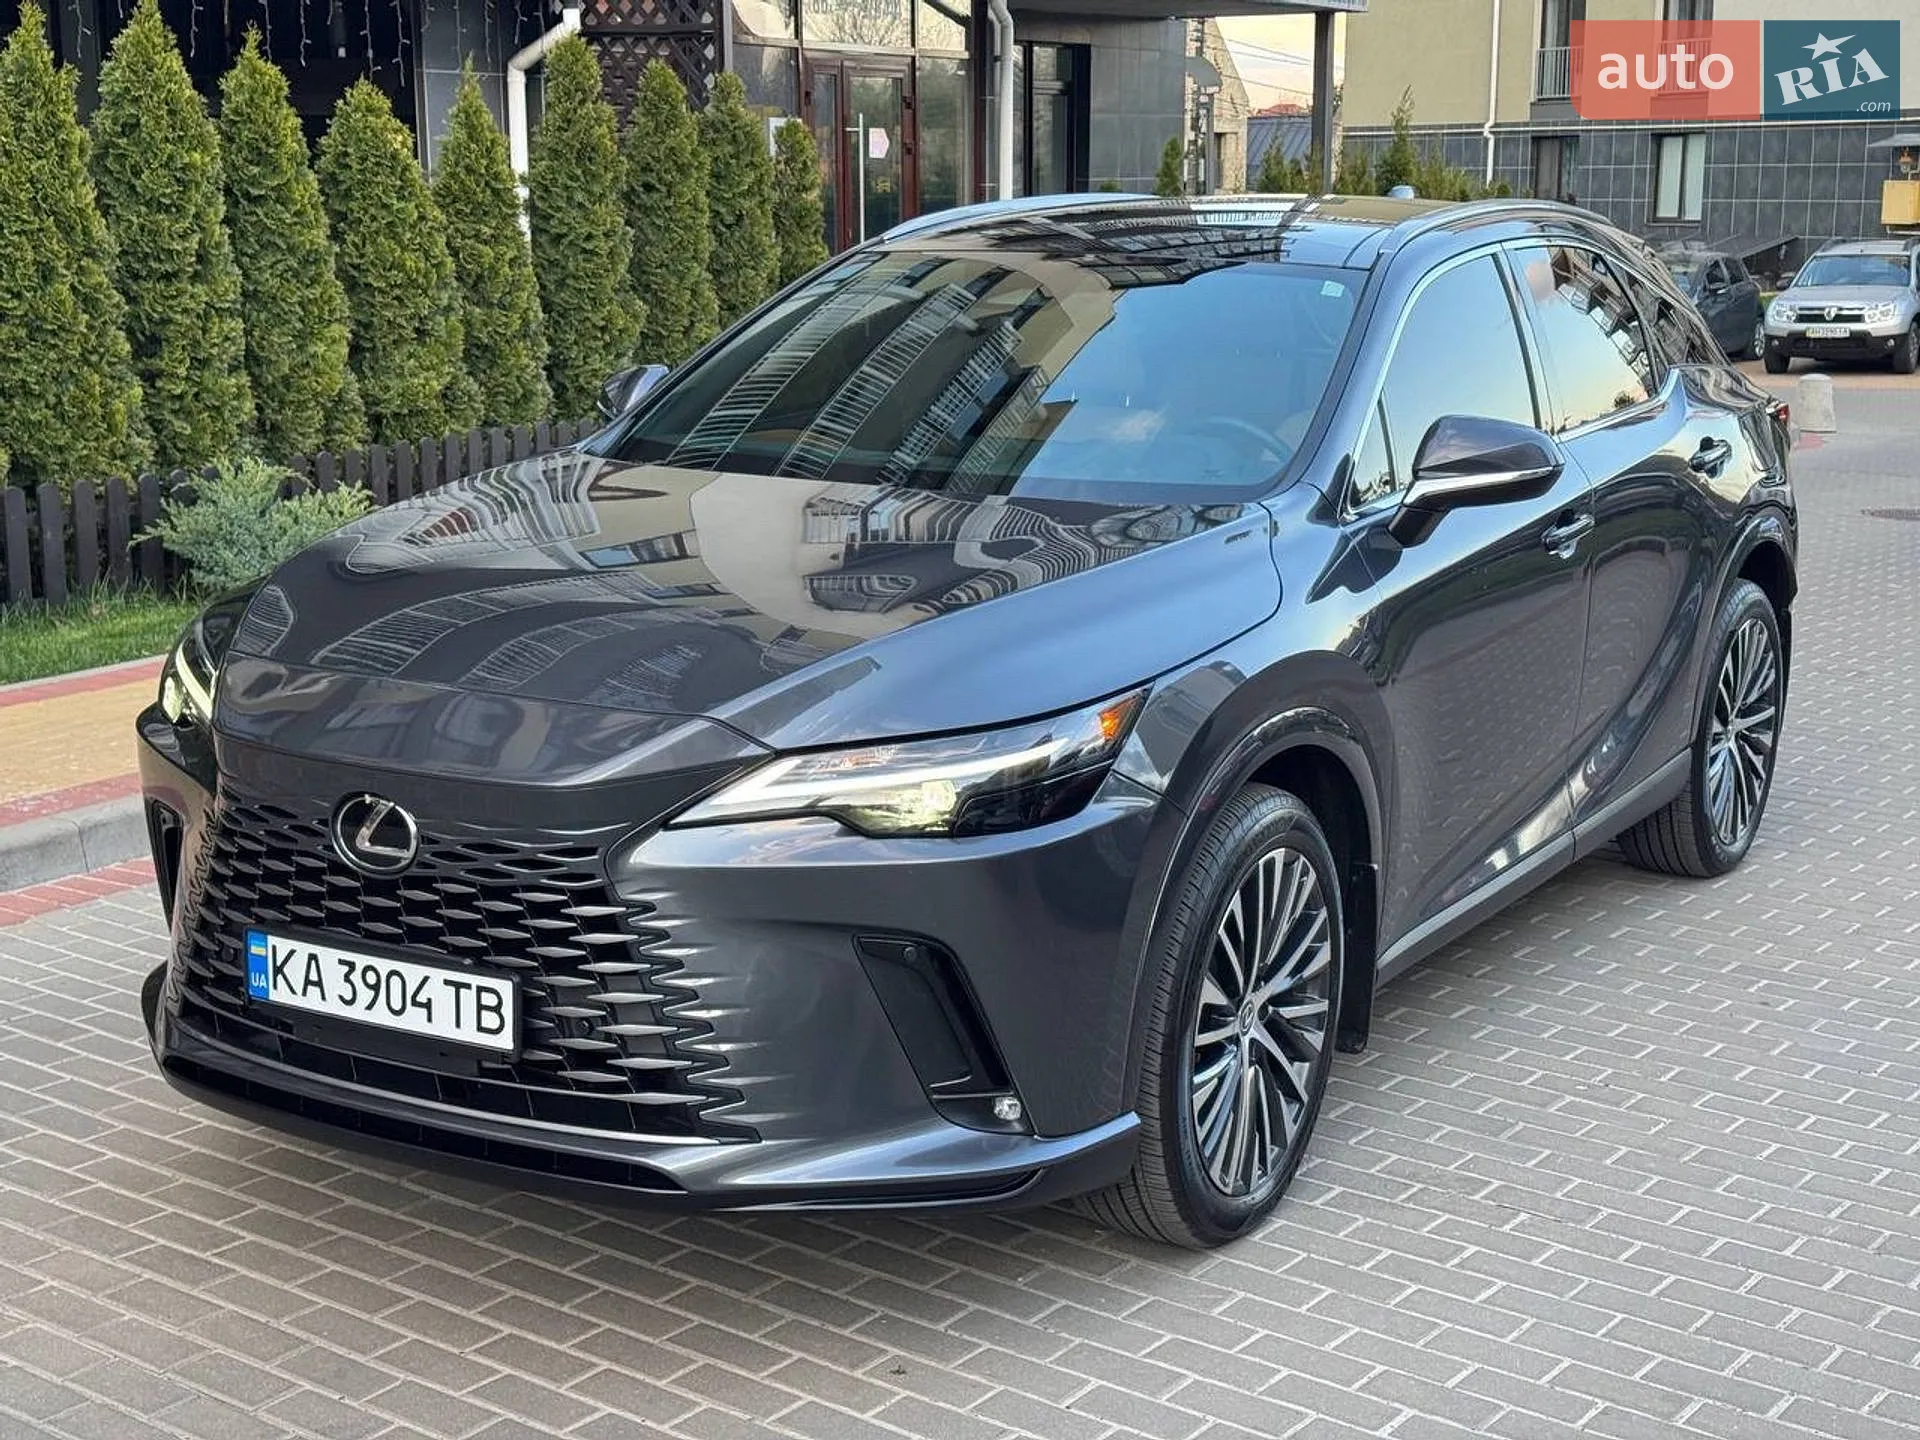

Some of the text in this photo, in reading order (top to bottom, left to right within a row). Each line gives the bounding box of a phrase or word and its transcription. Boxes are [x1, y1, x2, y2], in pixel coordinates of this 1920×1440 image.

[250, 975, 267, 988] UA
[271, 944, 506, 1036] KA 3904 TB
